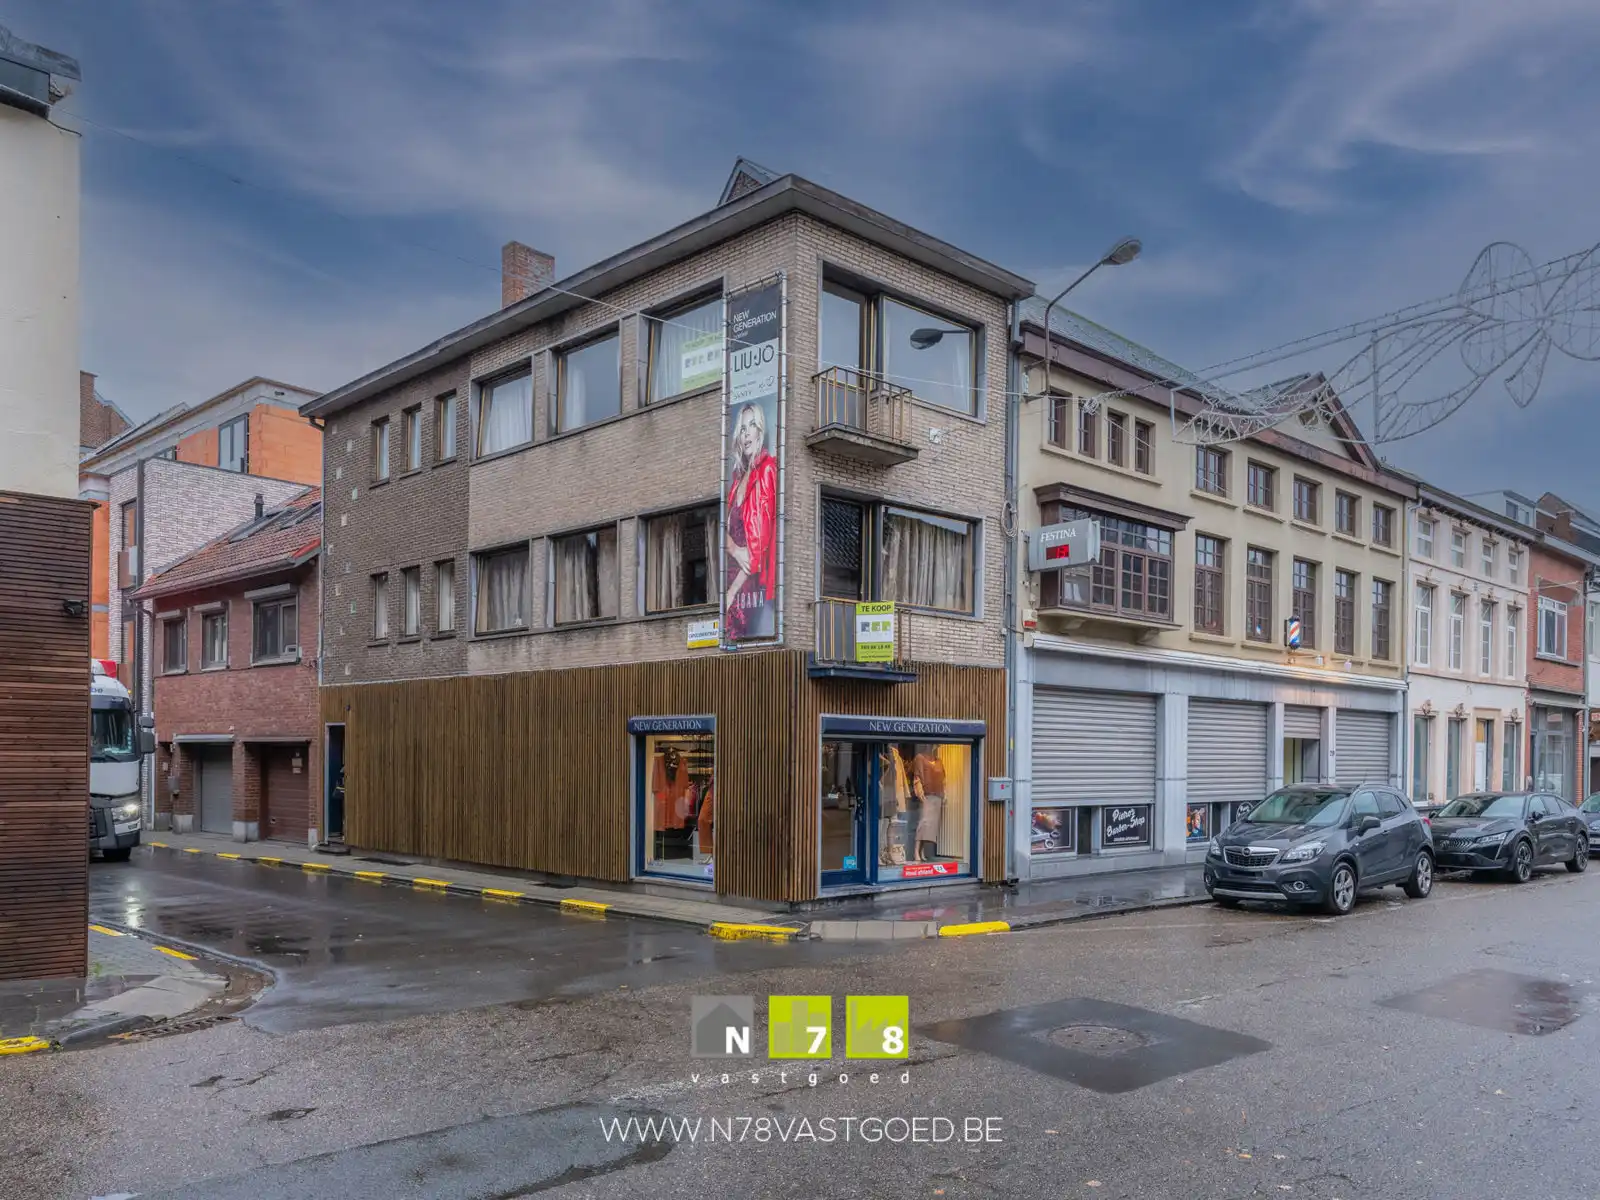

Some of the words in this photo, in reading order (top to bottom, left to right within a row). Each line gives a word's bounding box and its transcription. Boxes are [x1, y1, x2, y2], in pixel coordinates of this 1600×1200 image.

[733, 309, 750, 323] NEW
[733, 311, 777, 333] GENERATION
[1041, 527, 1076, 543] FESTINA
[861, 605, 870, 613] TE
[872, 604, 891, 612] KOOP
[634, 721, 651, 731] NEW
[652, 720, 702, 731] GENERATION
[869, 721, 892, 731] NEW
[893, 721, 952, 733] GENERATION
